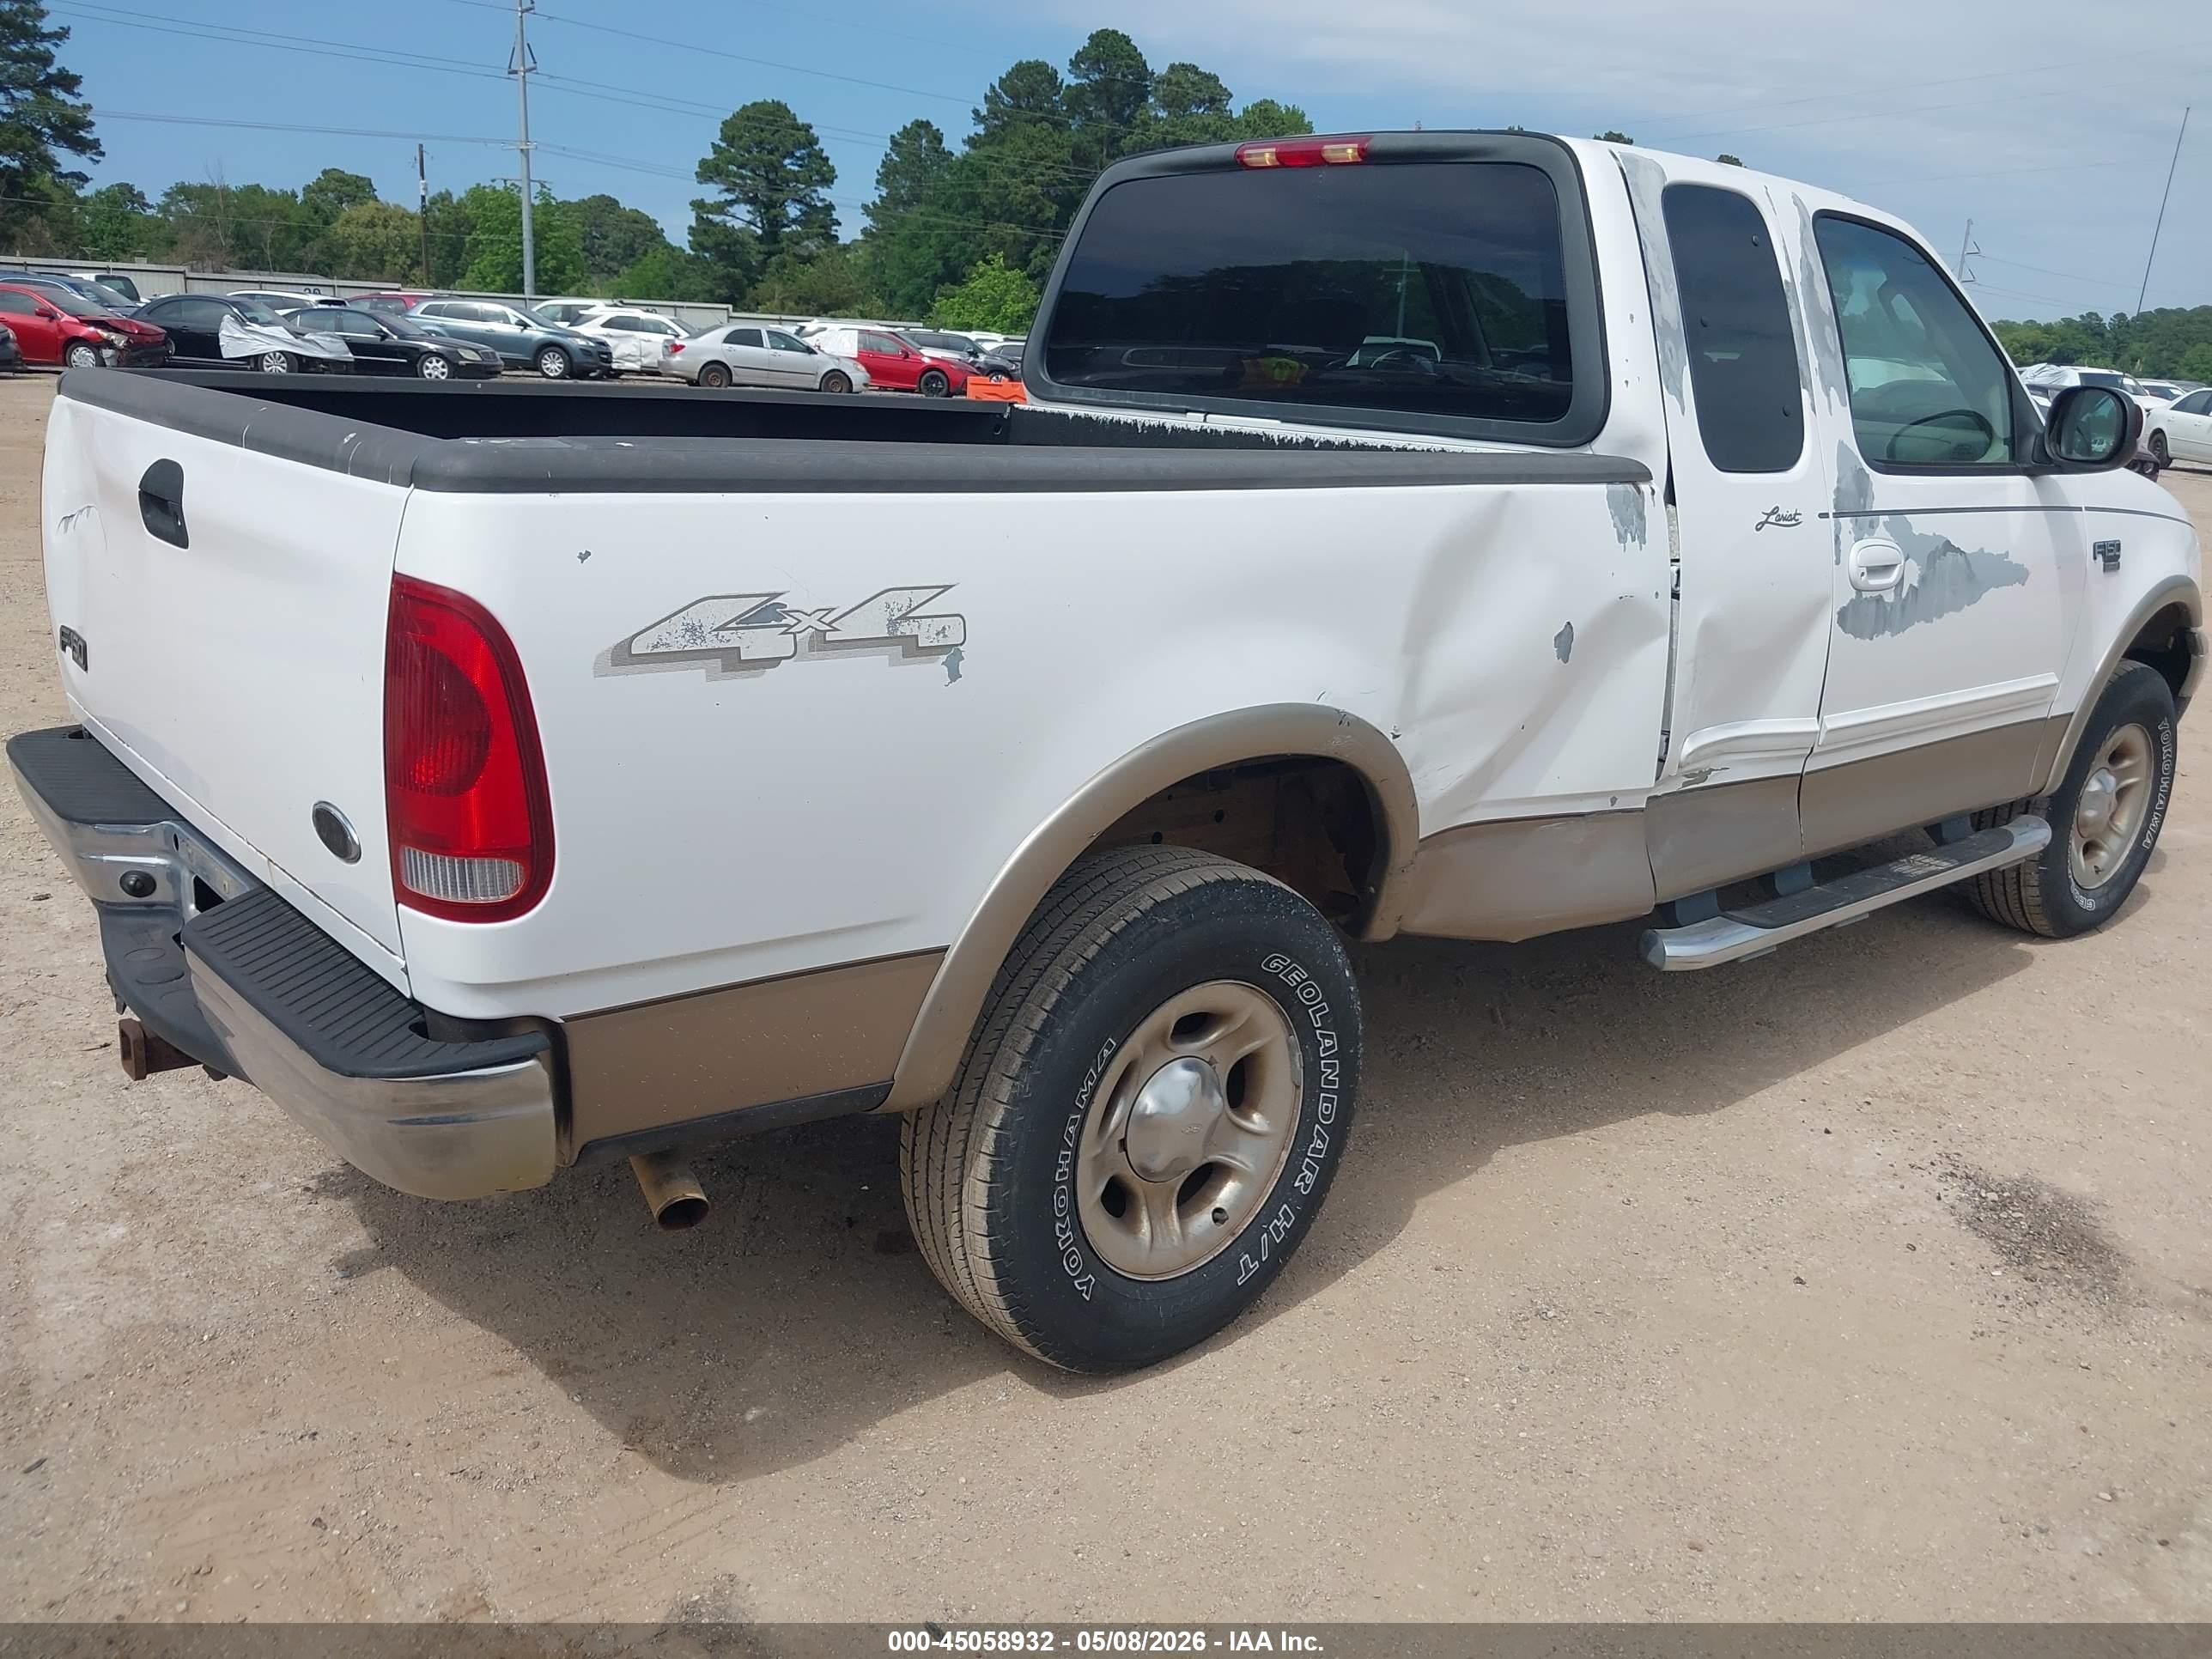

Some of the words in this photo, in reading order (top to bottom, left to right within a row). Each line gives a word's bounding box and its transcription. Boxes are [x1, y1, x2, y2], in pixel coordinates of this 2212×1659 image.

[1755, 506, 1803, 532] Lariat
[2142, 716, 2171, 850] YOKOHAMA
[1261, 952, 1340, 1195] GEOLANDAR
[1052, 1037, 1116, 1302] YOKOHAMA
[1237, 1202, 1296, 1287] H/T
